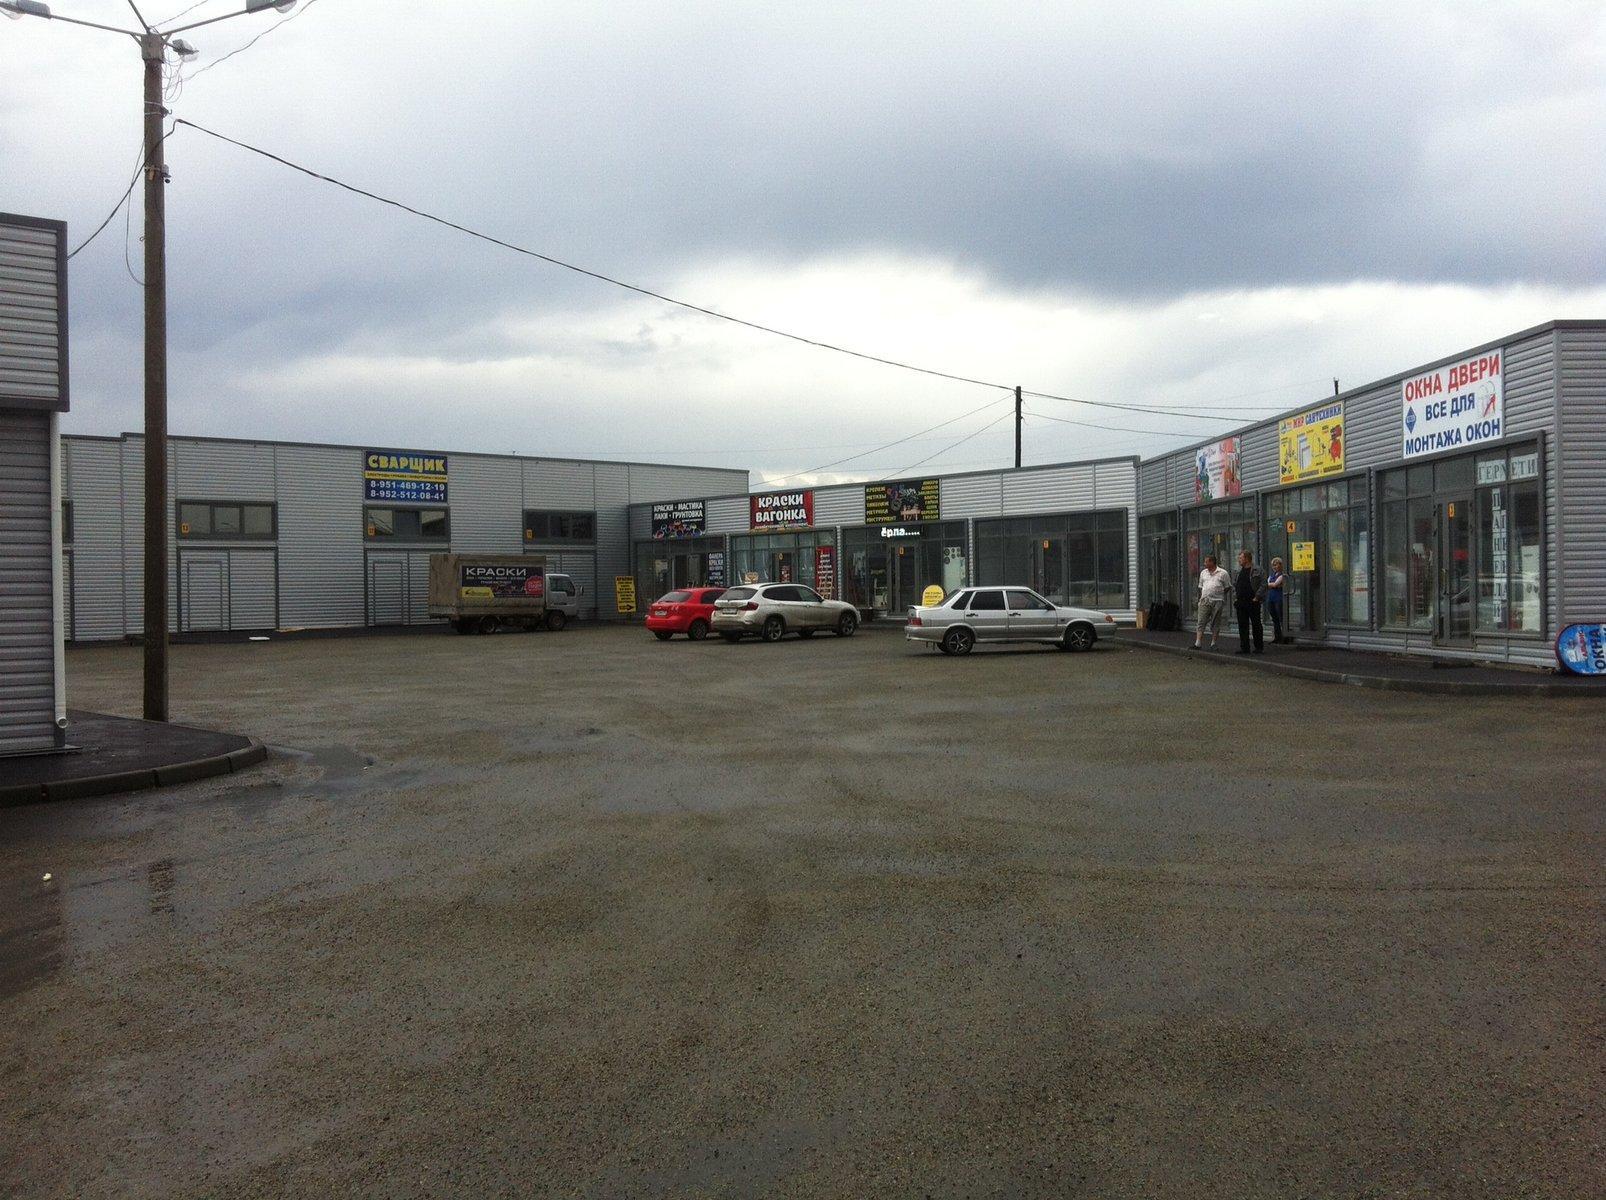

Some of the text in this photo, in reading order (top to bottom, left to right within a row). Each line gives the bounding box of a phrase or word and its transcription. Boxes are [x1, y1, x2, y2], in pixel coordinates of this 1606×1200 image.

[1405, 354, 1500, 402] ОКНА ДВЕРИ
[1425, 392, 1475, 421] ВСЕ ДЛЯ
[1405, 418, 1500, 455] МОНТАЖА ОКОН
[368, 454, 445, 472] СВАРЩИК
[654, 502, 703, 512] КРАСКИ МАСТИКА
[758, 494, 803, 508] КРАСКИ
[672, 510, 703, 519] ГРУНТОВКА
[755, 509, 807, 523] ВАГОНКА
[466, 567, 527, 576] КРАСКИ
